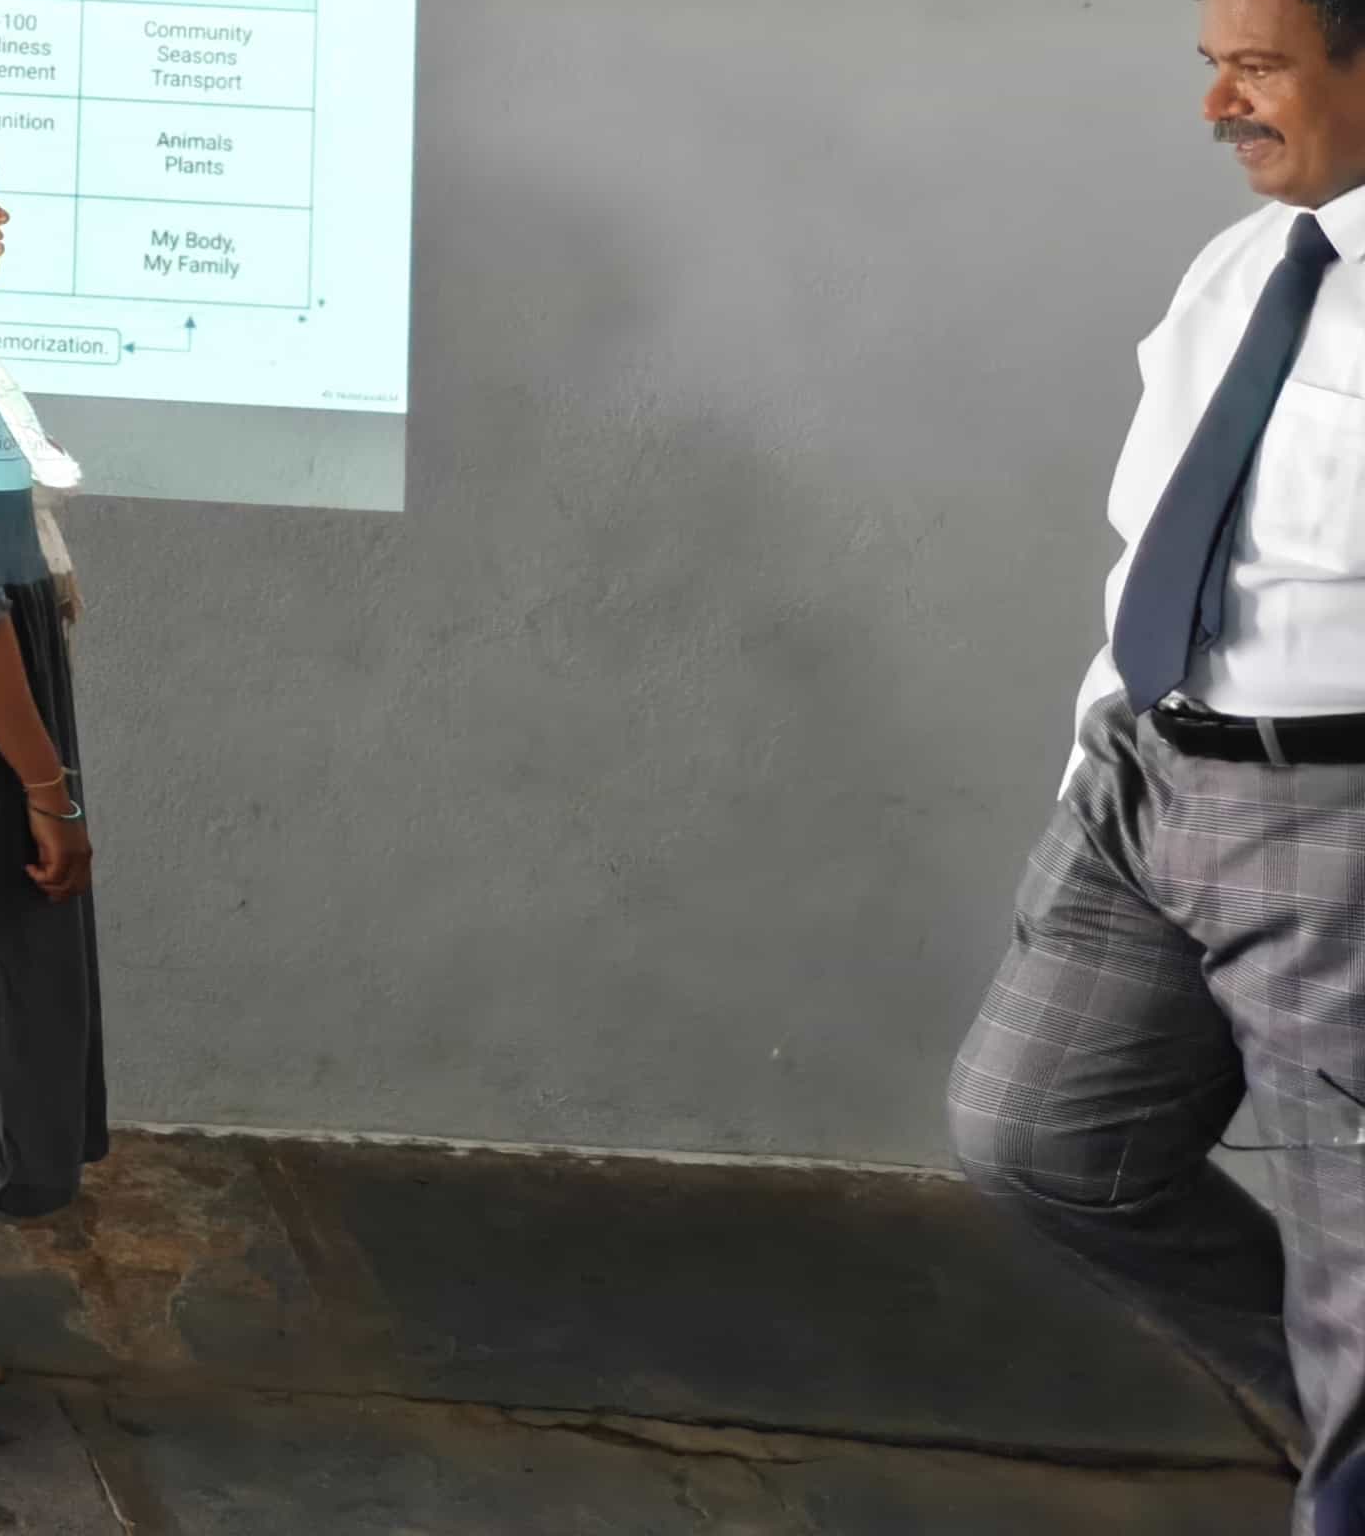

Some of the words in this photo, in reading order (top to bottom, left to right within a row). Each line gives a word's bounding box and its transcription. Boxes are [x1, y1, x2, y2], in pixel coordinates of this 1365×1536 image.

[143, 20, 253, 46] Community
[157, 45, 238, 65] Seasons
[151, 68, 242, 92] Transport
[156, 132, 233, 152] Animals
[165, 156, 225, 175] Plants
[151, 230, 179, 252] My
[186, 231, 236, 254] Body,
[143, 253, 172, 276] My
[178, 255, 240, 279] Family
